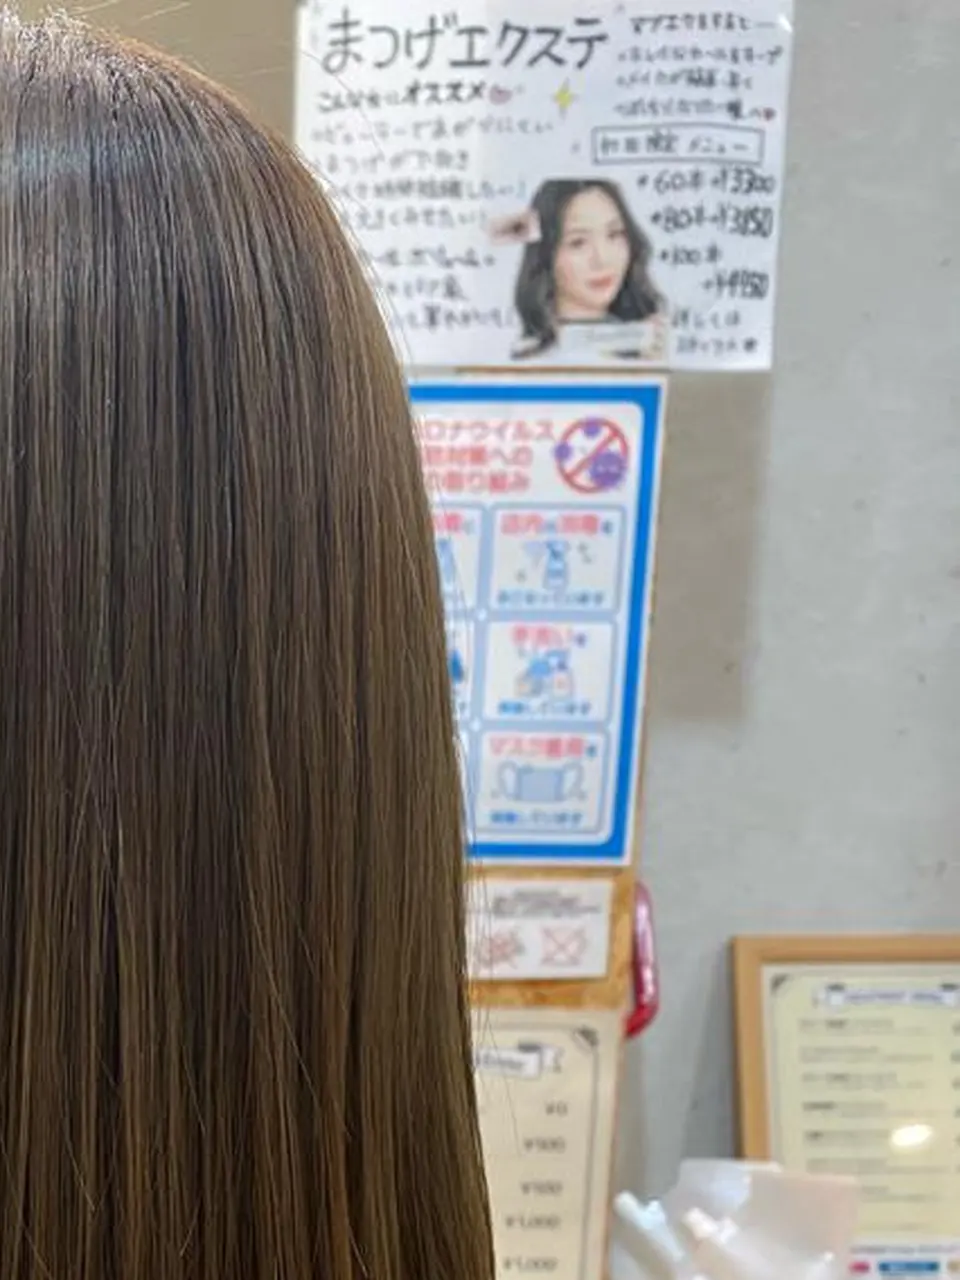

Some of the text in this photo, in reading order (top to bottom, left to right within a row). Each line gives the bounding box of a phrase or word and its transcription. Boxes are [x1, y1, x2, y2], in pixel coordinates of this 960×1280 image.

[321, 8, 608, 75] まつげエクステ
